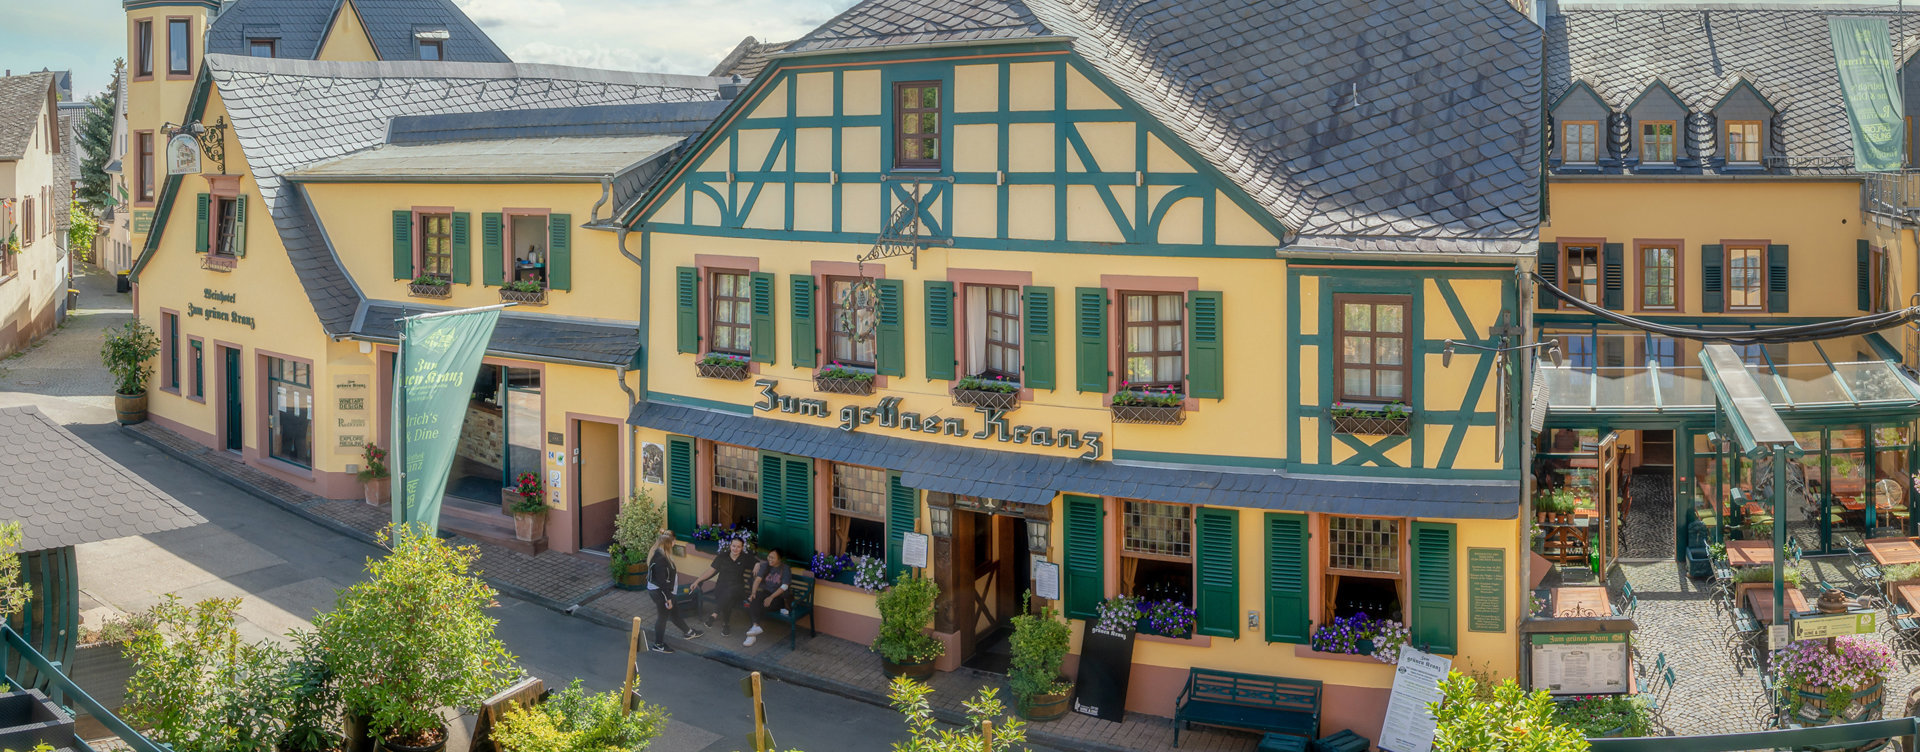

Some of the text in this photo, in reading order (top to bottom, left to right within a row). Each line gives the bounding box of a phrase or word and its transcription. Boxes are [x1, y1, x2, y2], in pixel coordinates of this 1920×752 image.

[203, 288, 236, 304] Weinhotel
[187, 302, 256, 330] Zum grünen Kranz
[425, 370, 464, 387] Kranz
[754, 378, 1104, 462] Zum grünen Kranz
[414, 428, 439, 442] Dine
[1549, 634, 1609, 644] Zum grünen Kranz
